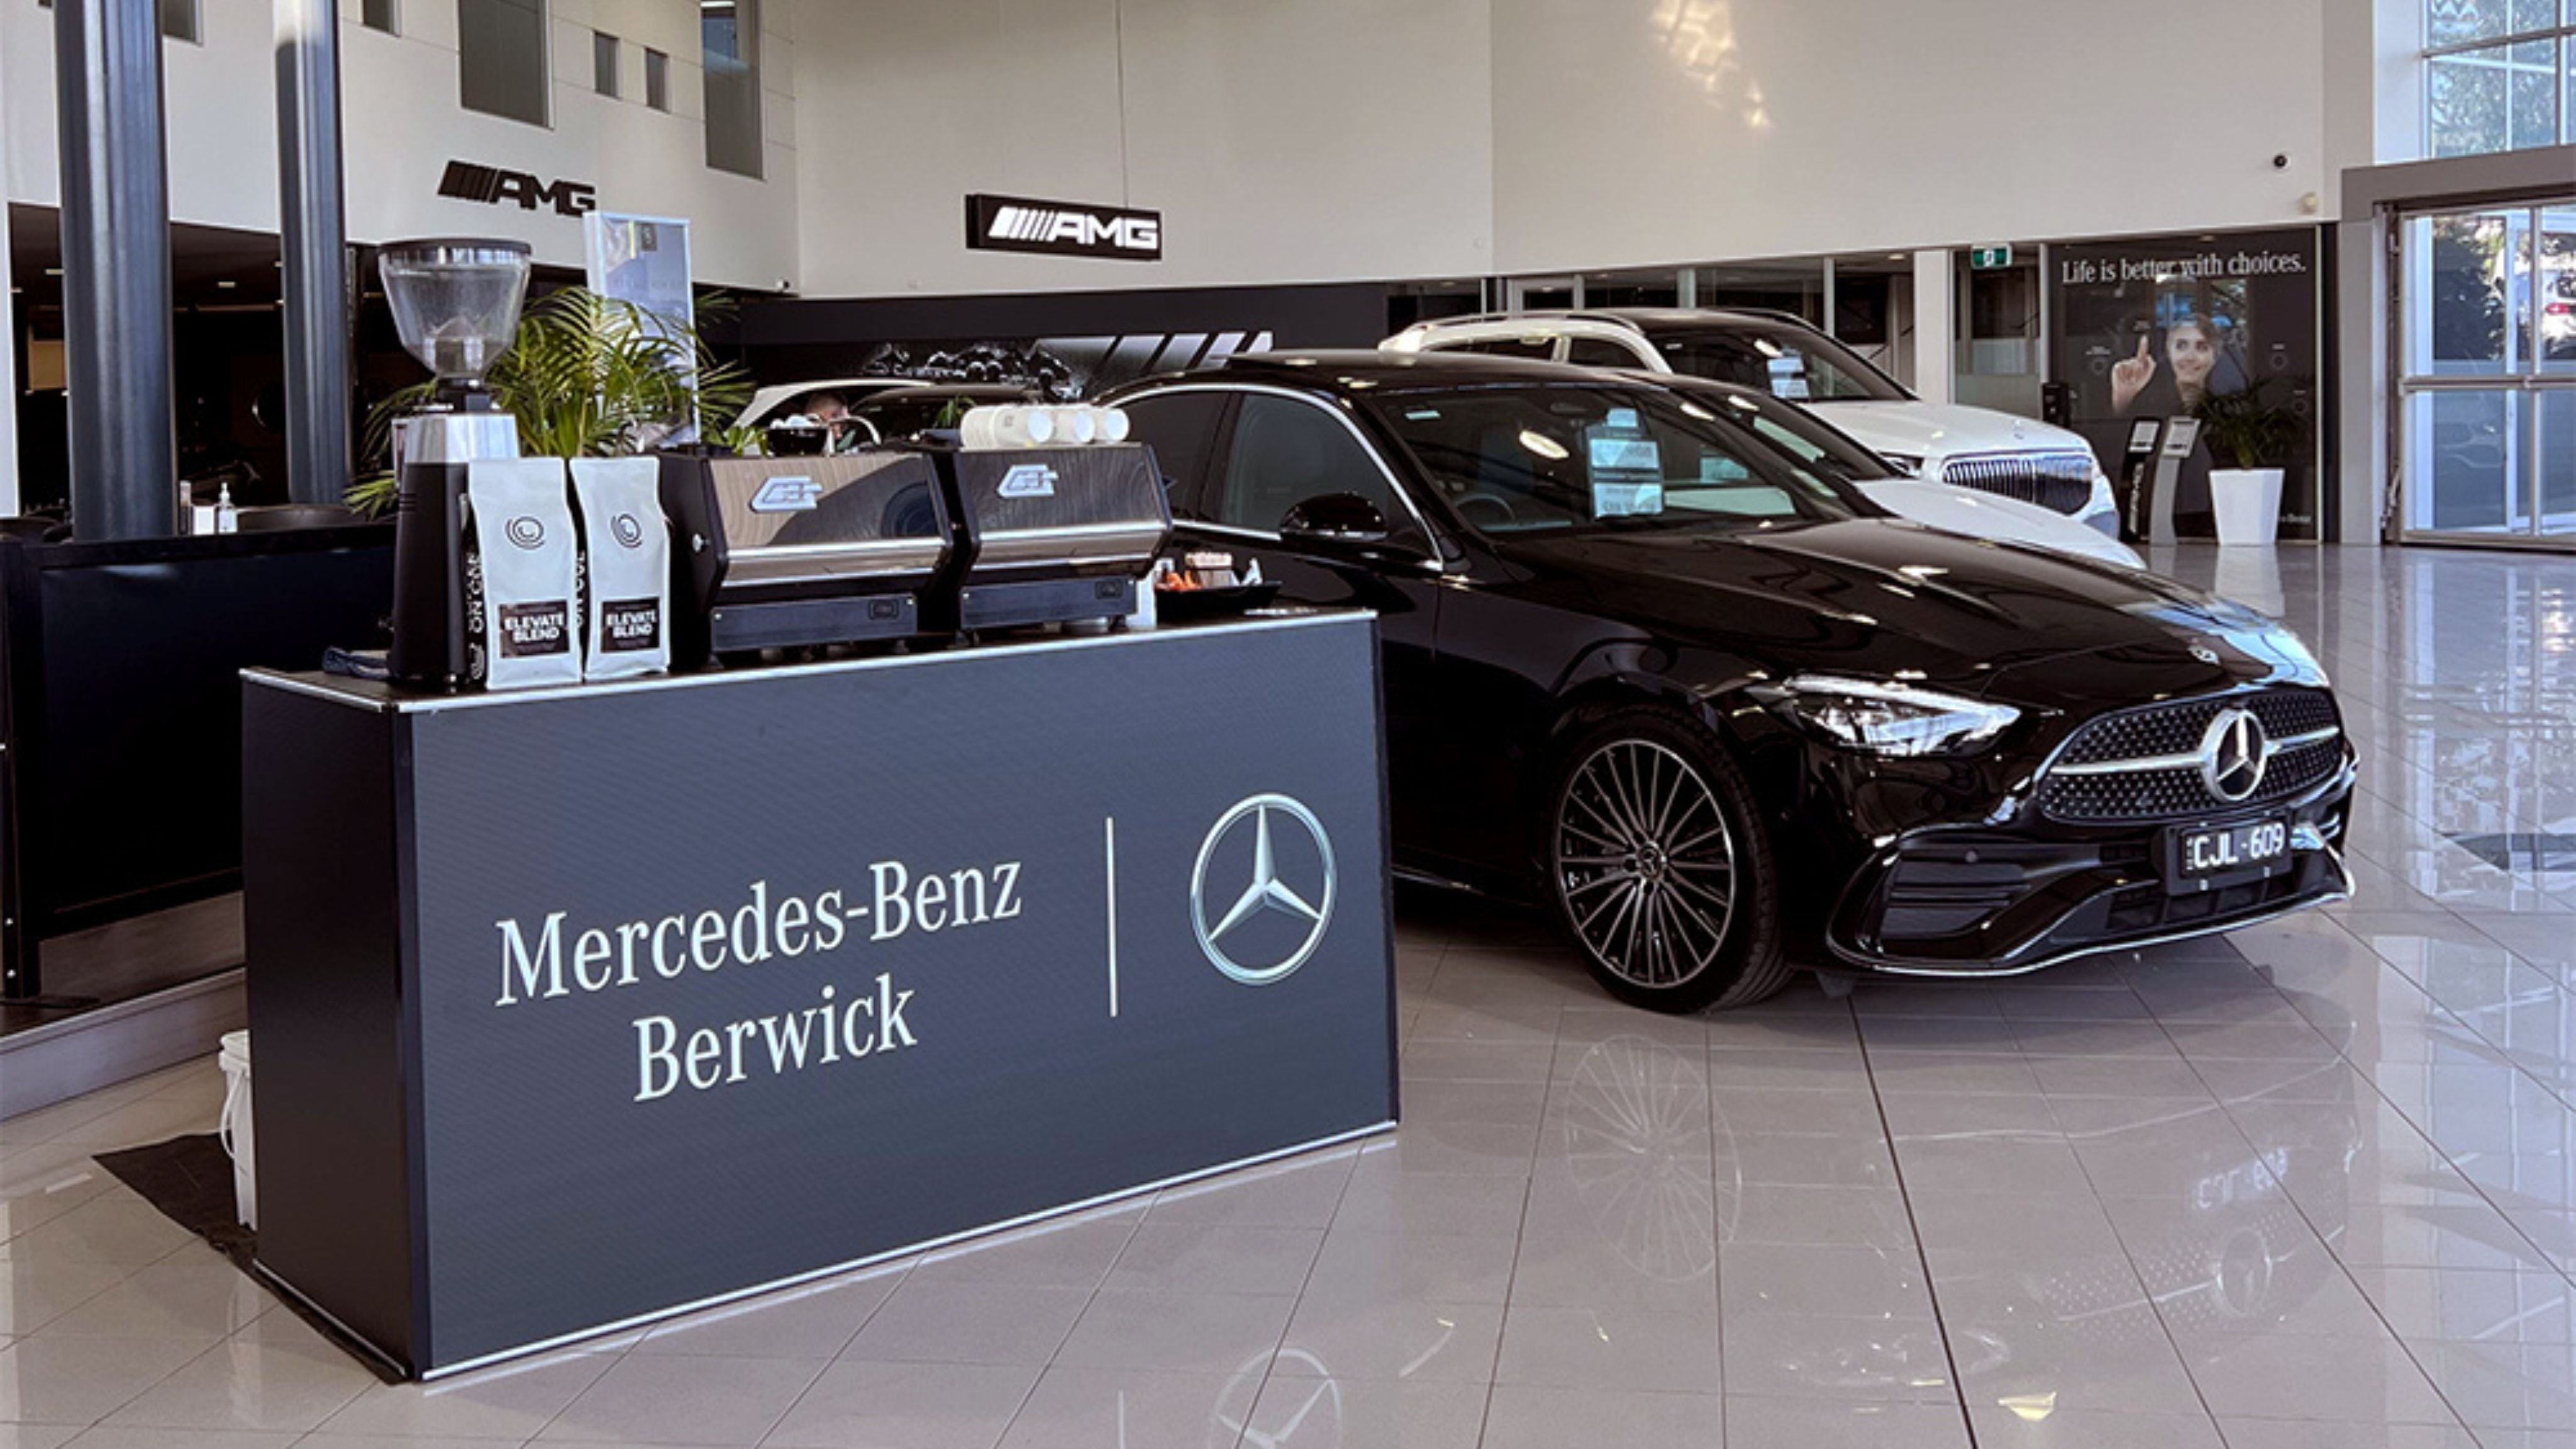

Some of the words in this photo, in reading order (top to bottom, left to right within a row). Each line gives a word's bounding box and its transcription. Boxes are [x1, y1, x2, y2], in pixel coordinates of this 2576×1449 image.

[489, 169, 596, 217] AMG
[1045, 211, 1158, 249] AMG
[2062, 260, 2096, 283] Life
[2101, 258, 2117, 281] is
[2119, 257, 2177, 280] better
[2178, 253, 2224, 277] with
[2228, 250, 2306, 275] choices.
[504, 613, 564, 630] ELEVATE
[606, 609, 657, 626] ELEVATE
[613, 623, 653, 638] BLEND
[513, 627, 560, 642] BLEND
[494, 860, 1023, 1007] Mercedes-Benz
[633, 972, 918, 1103] Berwick
